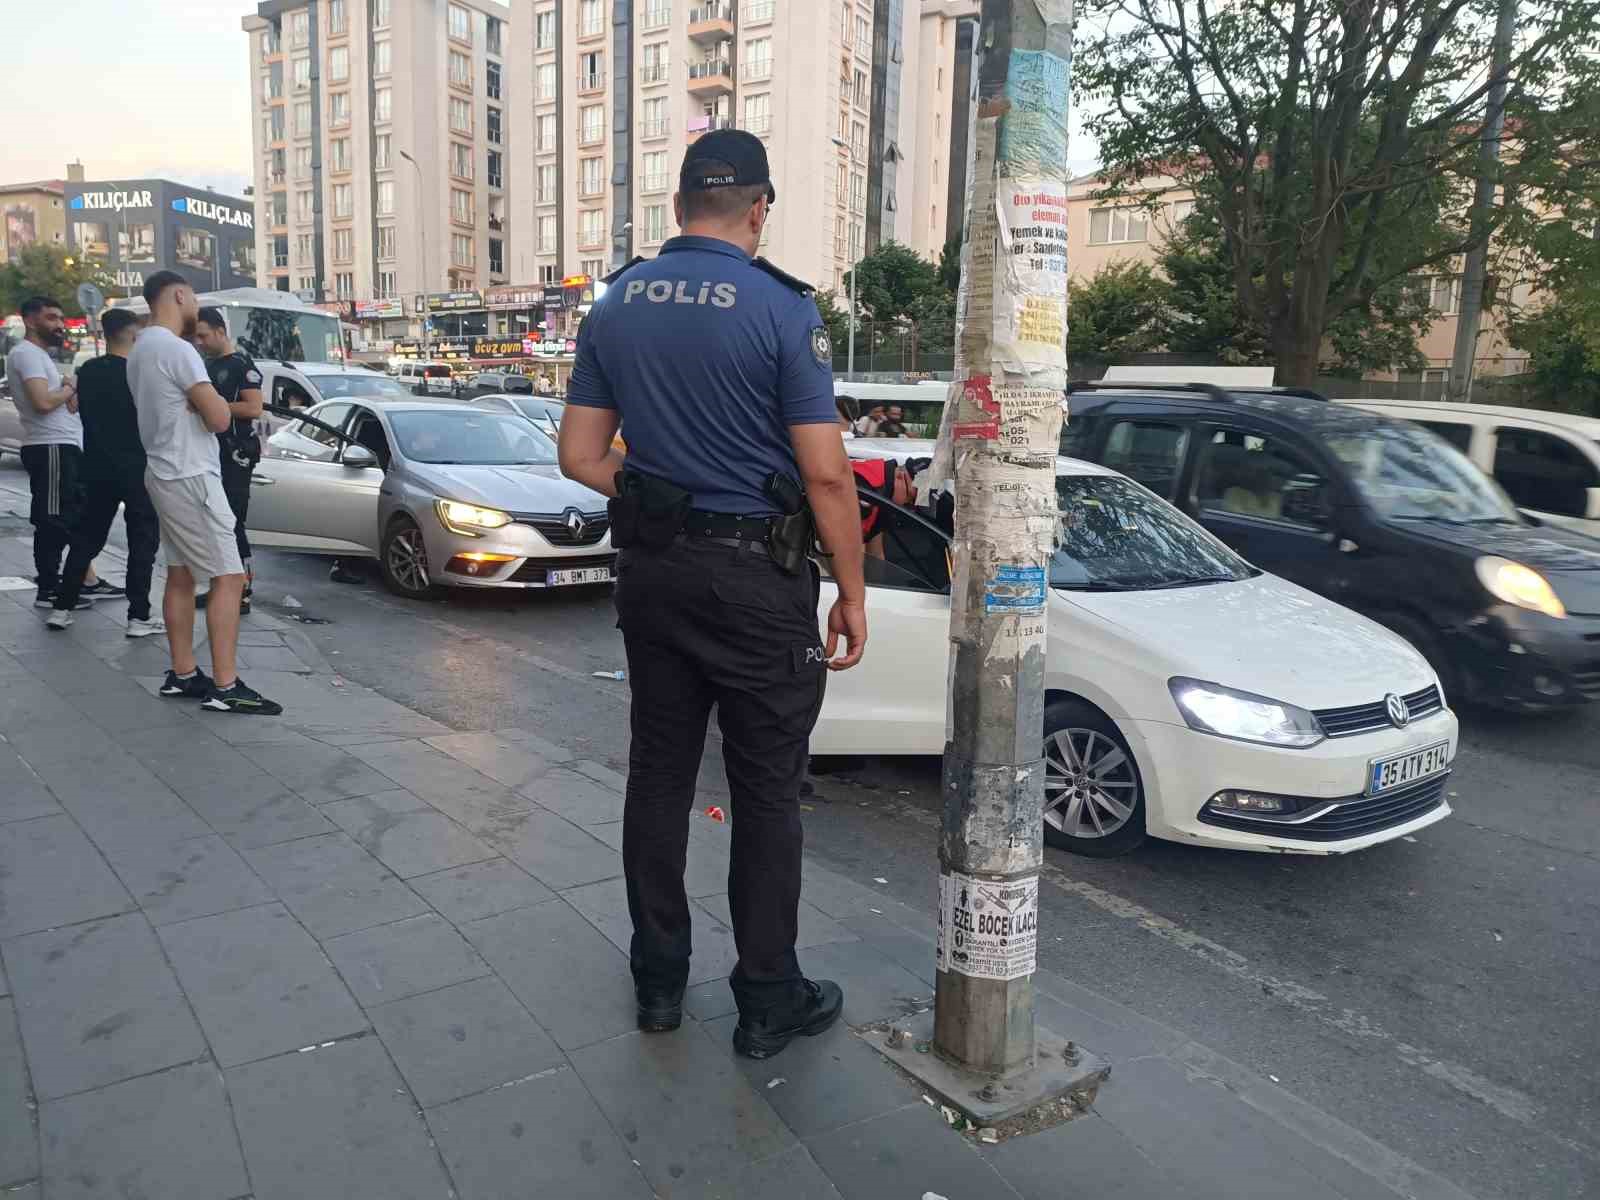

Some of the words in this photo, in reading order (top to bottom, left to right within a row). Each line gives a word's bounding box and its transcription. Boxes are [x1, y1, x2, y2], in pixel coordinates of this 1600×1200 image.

[83, 191, 152, 212] KILIÇLAR
[186, 198, 252, 228] KILIÇLAR
[1010, 226, 1042, 239] Yemek
[1382, 761, 1397, 786] 35
[1400, 754, 1423, 781] ATY
[1425, 746, 1445, 773] 314
[953, 907, 975, 932] EZEL
